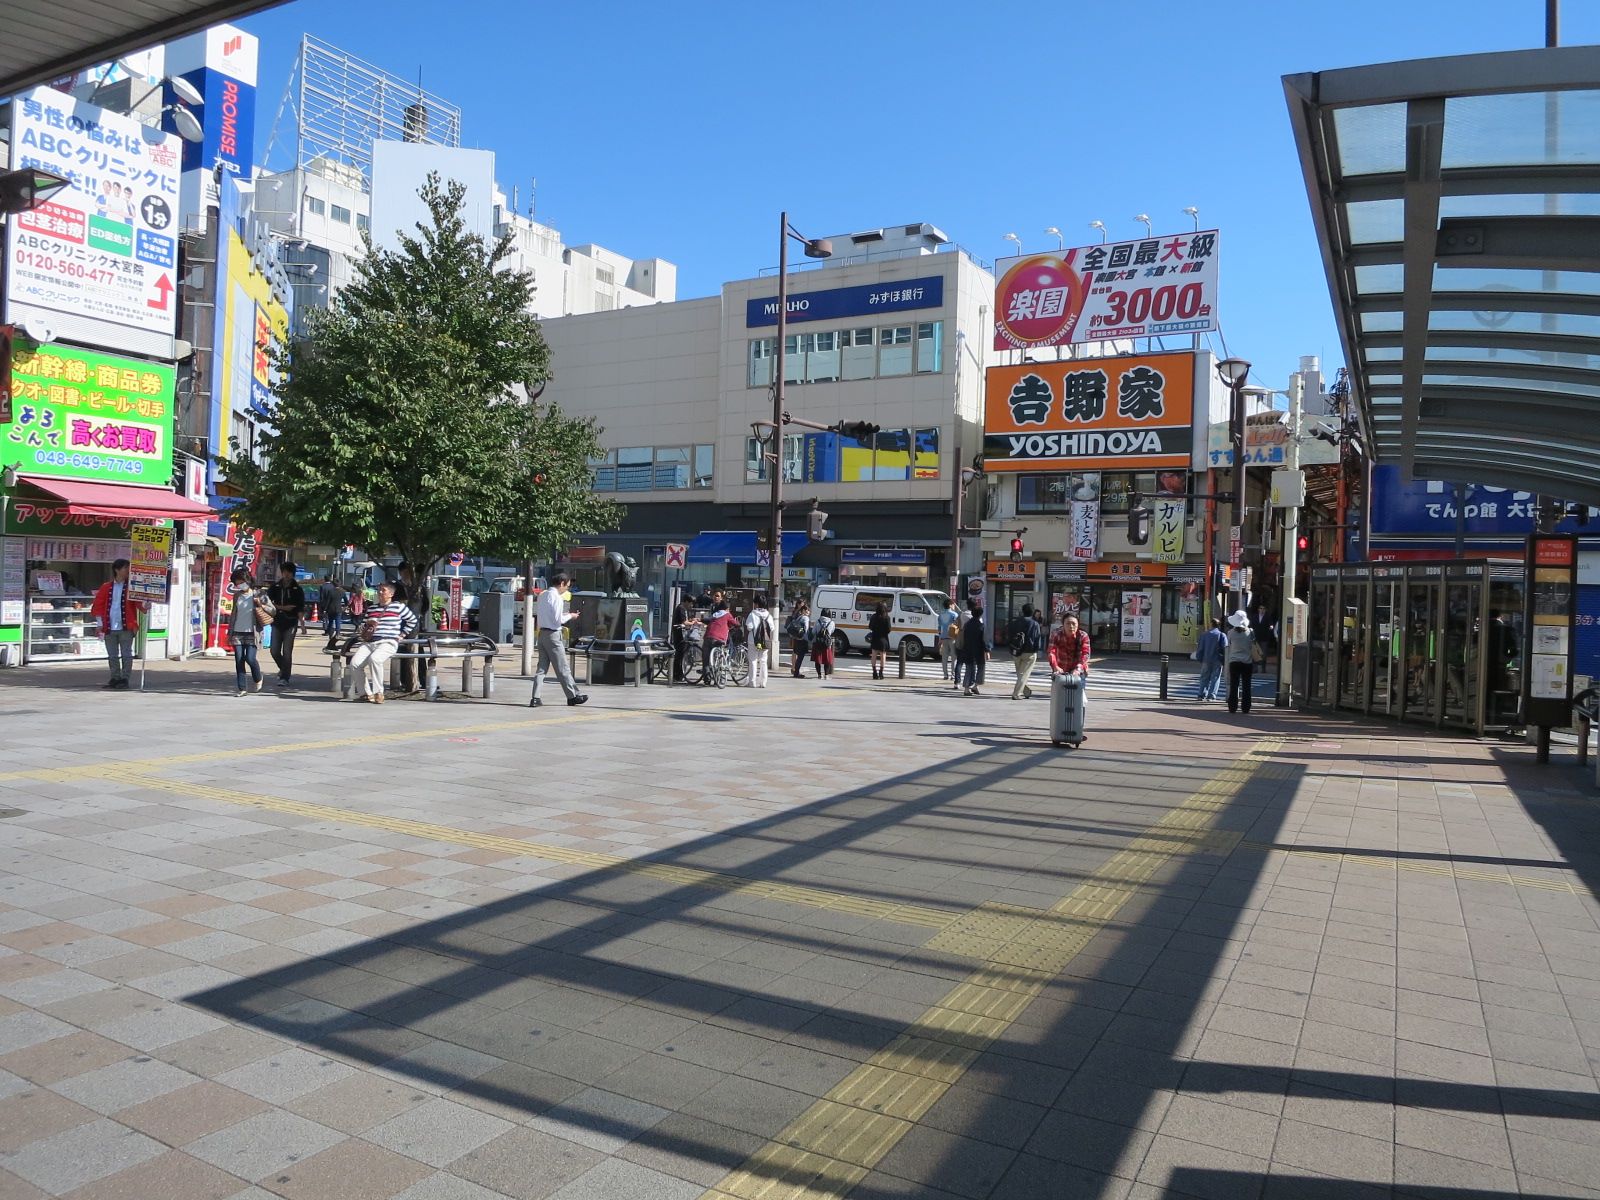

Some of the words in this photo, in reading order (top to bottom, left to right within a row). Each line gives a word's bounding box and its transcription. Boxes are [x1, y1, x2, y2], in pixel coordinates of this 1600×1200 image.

[22, 97, 142, 156] 男性の悩みは
[221, 80, 240, 157] PROMISE
[21, 127, 178, 195] ABCクリニックに
[21, 210, 85, 240] 包茎治療
[16, 250, 115, 286] 0120-560-477
[17, 234, 145, 278] ABCクリニック大宮院
[1081, 233, 1216, 272] 全国最大級
[26, 286, 81, 304] ABCクリニック
[764, 300, 810, 315] MIUHO
[869, 287, 924, 305] みずほ銀行
[1007, 286, 1069, 322] 楽園
[995, 320, 1028, 349] EXCITING
[1030, 313, 1078, 349] AMUSEMENT
[71, 419, 157, 454] 高くお買取
[1009, 431, 1163, 457] YOSHINOYA
[35, 450, 143, 474] 048-649-7749
[1080, 504, 1094, 548] 麦とろ
[1159, 502, 1179, 553] カルビ
